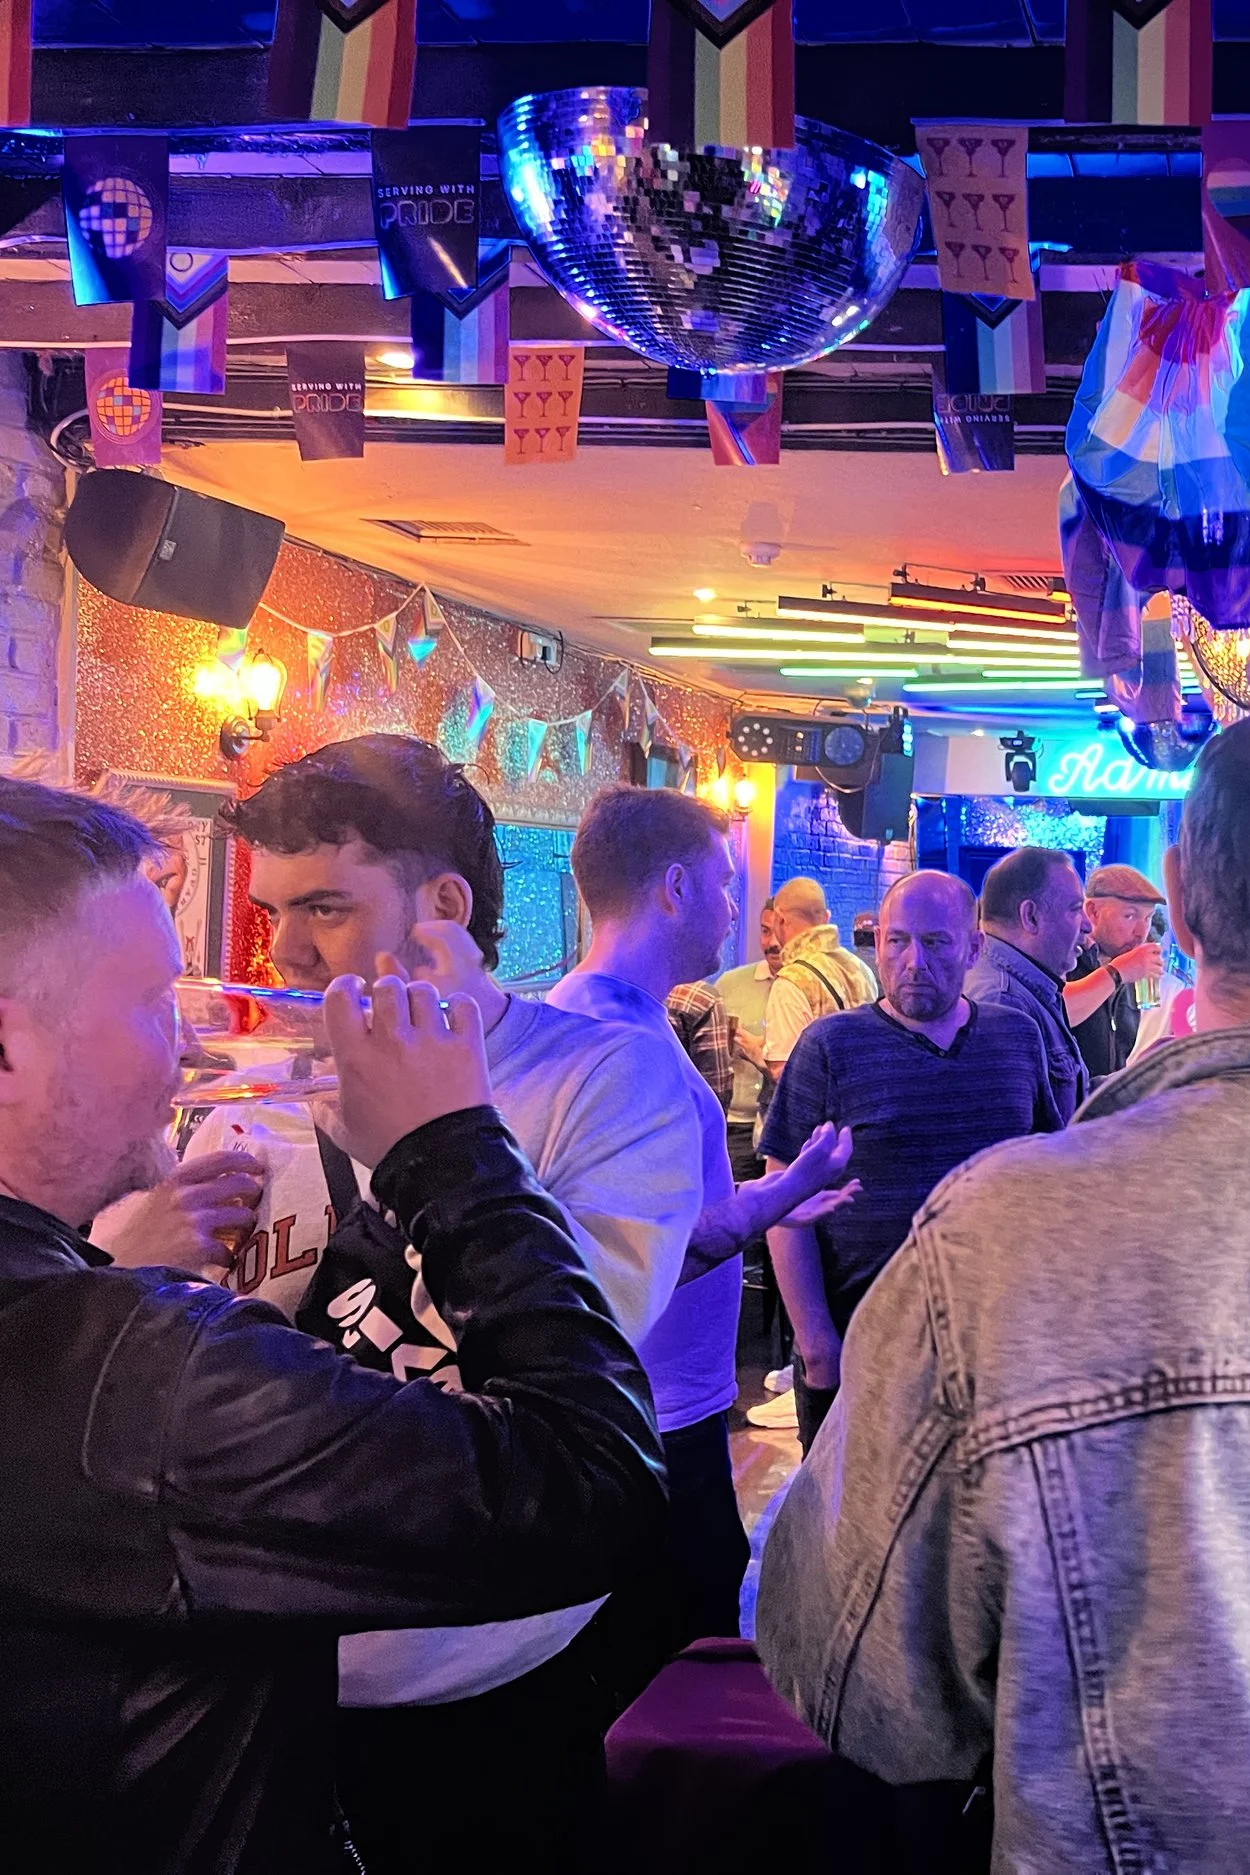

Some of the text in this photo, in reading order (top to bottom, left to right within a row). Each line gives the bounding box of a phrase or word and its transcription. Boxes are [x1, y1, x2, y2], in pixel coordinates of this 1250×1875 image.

[378, 184, 475, 198] SERVING WITH
[380, 199, 475, 229] PRIDE
[291, 382, 362, 391] SERVING WITH
[292, 393, 362, 413] PRIDE
